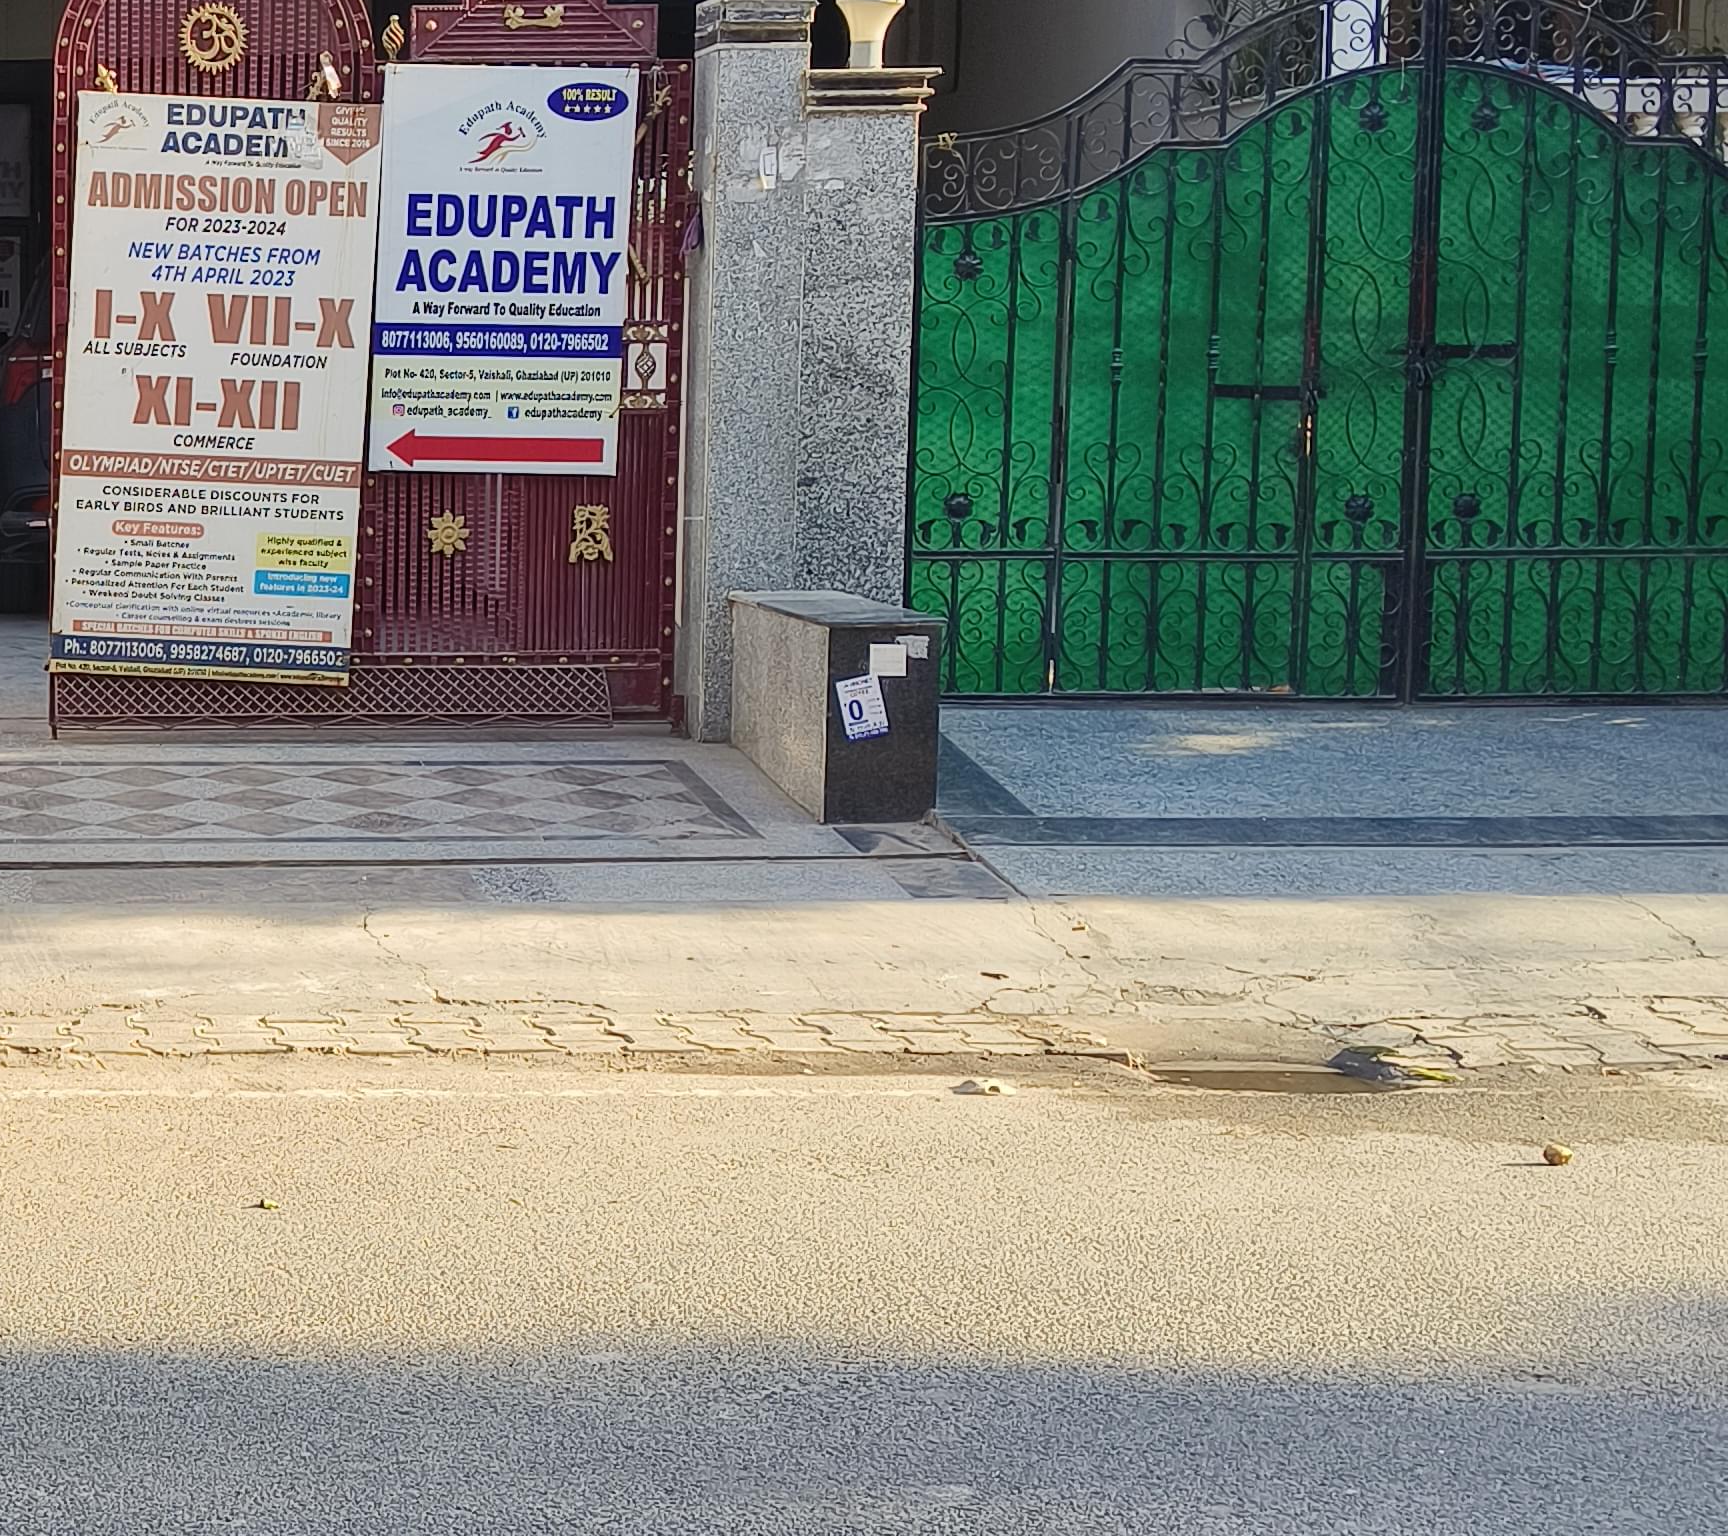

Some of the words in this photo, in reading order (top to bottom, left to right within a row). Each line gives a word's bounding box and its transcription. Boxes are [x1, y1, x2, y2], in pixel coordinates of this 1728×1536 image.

[562, 88, 584, 102] 100%
[585, 88, 618, 102] RESULT
[167, 103, 306, 130] EDUPATH
[458, 100, 503, 136] Edupath
[506, 100, 547, 139] Academy
[330, 127, 367, 137] RESULTS
[160, 131, 296, 158] ACADEM
[87, 170, 276, 215] ADMISSION
[285, 178, 369, 218] OPEN
[165, 217, 199, 232] FOR
[202, 219, 287, 236] 2023-2024
[406, 193, 616, 239] EDUPATH
[128, 242, 174, 260] NEW
[177, 244, 263, 264] BATCHES
[266, 248, 321, 266] FROM
[151, 265, 187, 283] 4TH
[191, 266, 244, 285] APRIL
[250, 269, 296, 287] 2023
[395, 248, 622, 295] ACADEMY
[93, 289, 176, 342] I-X
[207, 293, 355, 349] VII-X
[412, 302, 421, 314] A
[423, 302, 445, 318] Way
[448, 302, 490, 315] Forward
[494, 303, 506, 315] To
[509, 302, 546, 319] Quality
[548, 303, 601, 317] Education
[83, 340, 110, 355] ALL
[114, 342, 187, 358] SUBJECTS
[381, 330, 453, 353] 8077113006,
[455, 331, 528, 354] 9560160089,
[530, 332, 609, 351] 0120-7966502
[229, 352, 328, 369] FOUNDATION
[384, 368, 401, 379] Plot
[439, 368, 477, 382] Sector-5,
[580, 371, 611, 382] 201010
[132, 374, 301, 431] XI-XII
[173, 434, 256, 451] COMMERCE
[69, 454, 357, 484] OLYMPIAD/NTSE/CTET/UPTET/CUET
[102, 485, 207, 500] CONSIDERABLE
[210, 490, 288, 504] DISCOUNTS
[291, 493, 320, 505] FOR
[76, 499, 120, 511] EARLY
[123, 501, 164, 513] BIRDS
[167, 503, 197, 514] AND
[200, 505, 271, 518] BRILLIANT
[274, 508, 345, 521] STUDENTS
[115, 522, 139, 535] Key
[143, 523, 202, 536] Features:
[267, 536, 295, 547] Highly
[296, 537, 334, 547] qualified
[316, 549, 348, 559] subject
[111, 559, 143, 568] Sample
[172, 561, 207, 571] Practice
[183, 572, 204, 582] With
[89, 640, 167, 662] 8077113006,
[170, 643, 250, 665] 9958274687,
[253, 647, 346, 667] 0120-7966502
